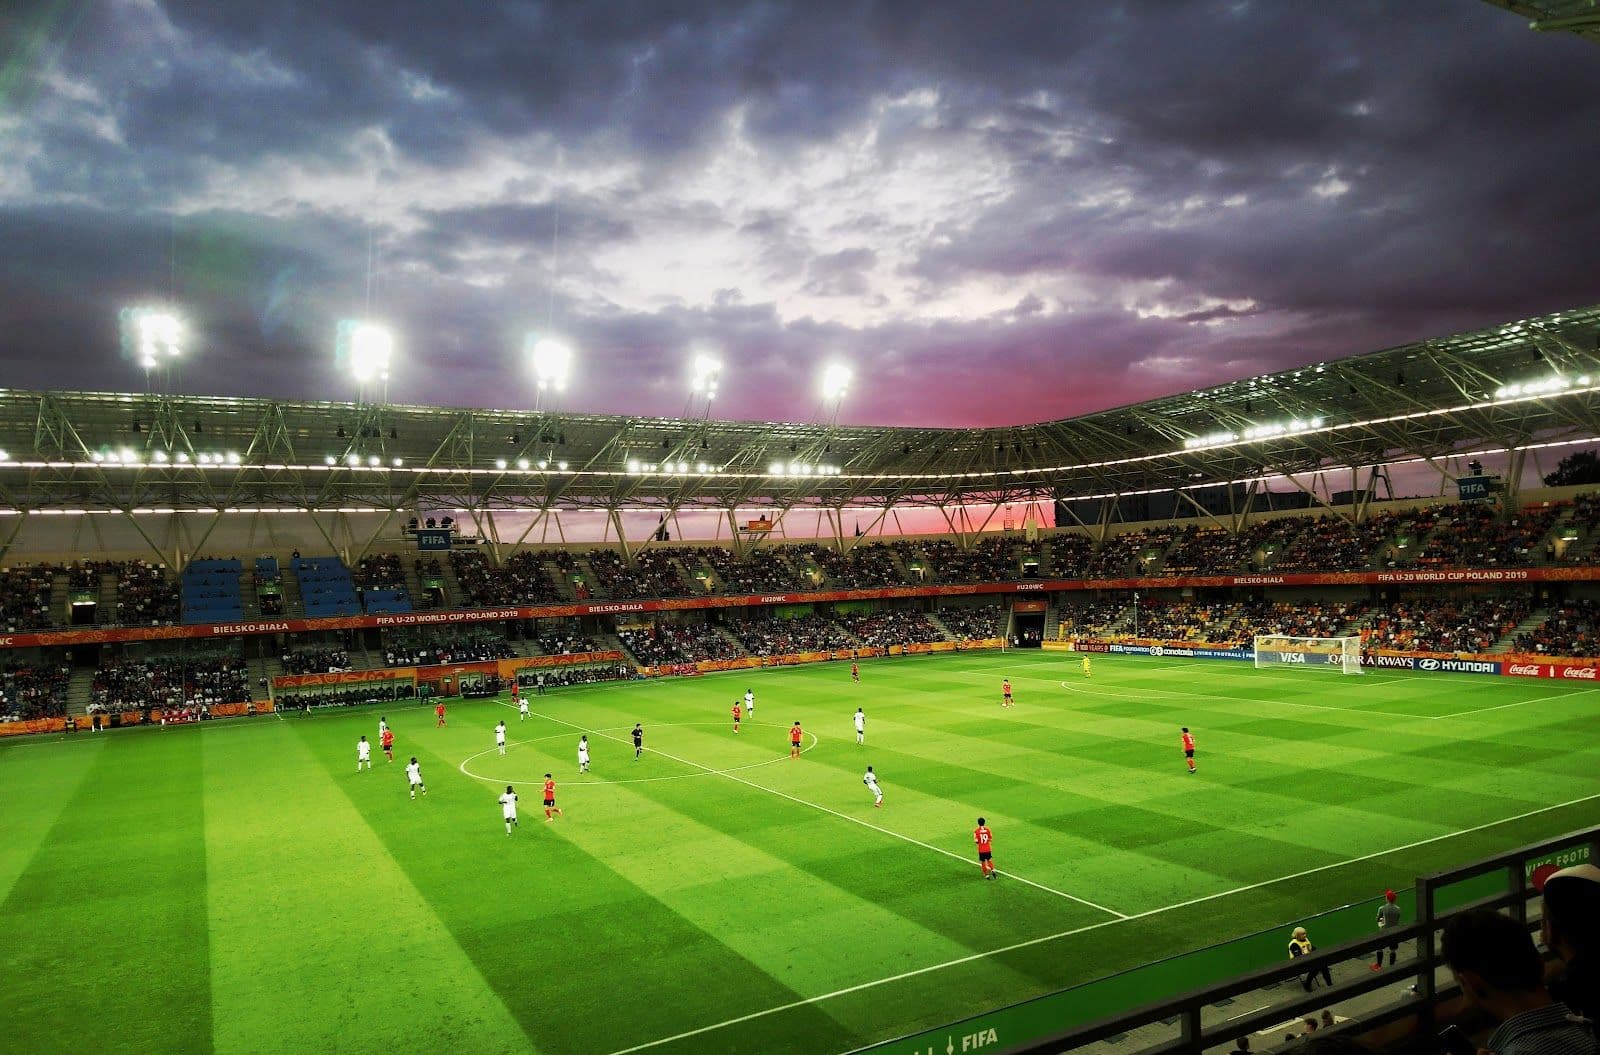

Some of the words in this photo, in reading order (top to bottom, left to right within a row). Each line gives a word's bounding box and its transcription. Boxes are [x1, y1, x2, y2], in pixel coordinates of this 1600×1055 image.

[1460, 484, 1486, 494] FIFA
[422, 536, 446, 544] FIFA
[1505, 571, 1528, 579] 2019
[417, 614, 446, 622] WORLD
[466, 611, 498, 619] POLAND
[1280, 652, 1305, 663] VISA
[1366, 656, 1414, 667] ARWAYS
[1442, 661, 1494, 673] HYUNDAI
[980, 833, 988, 844] 19
[962, 1028, 998, 1052] FIFA
